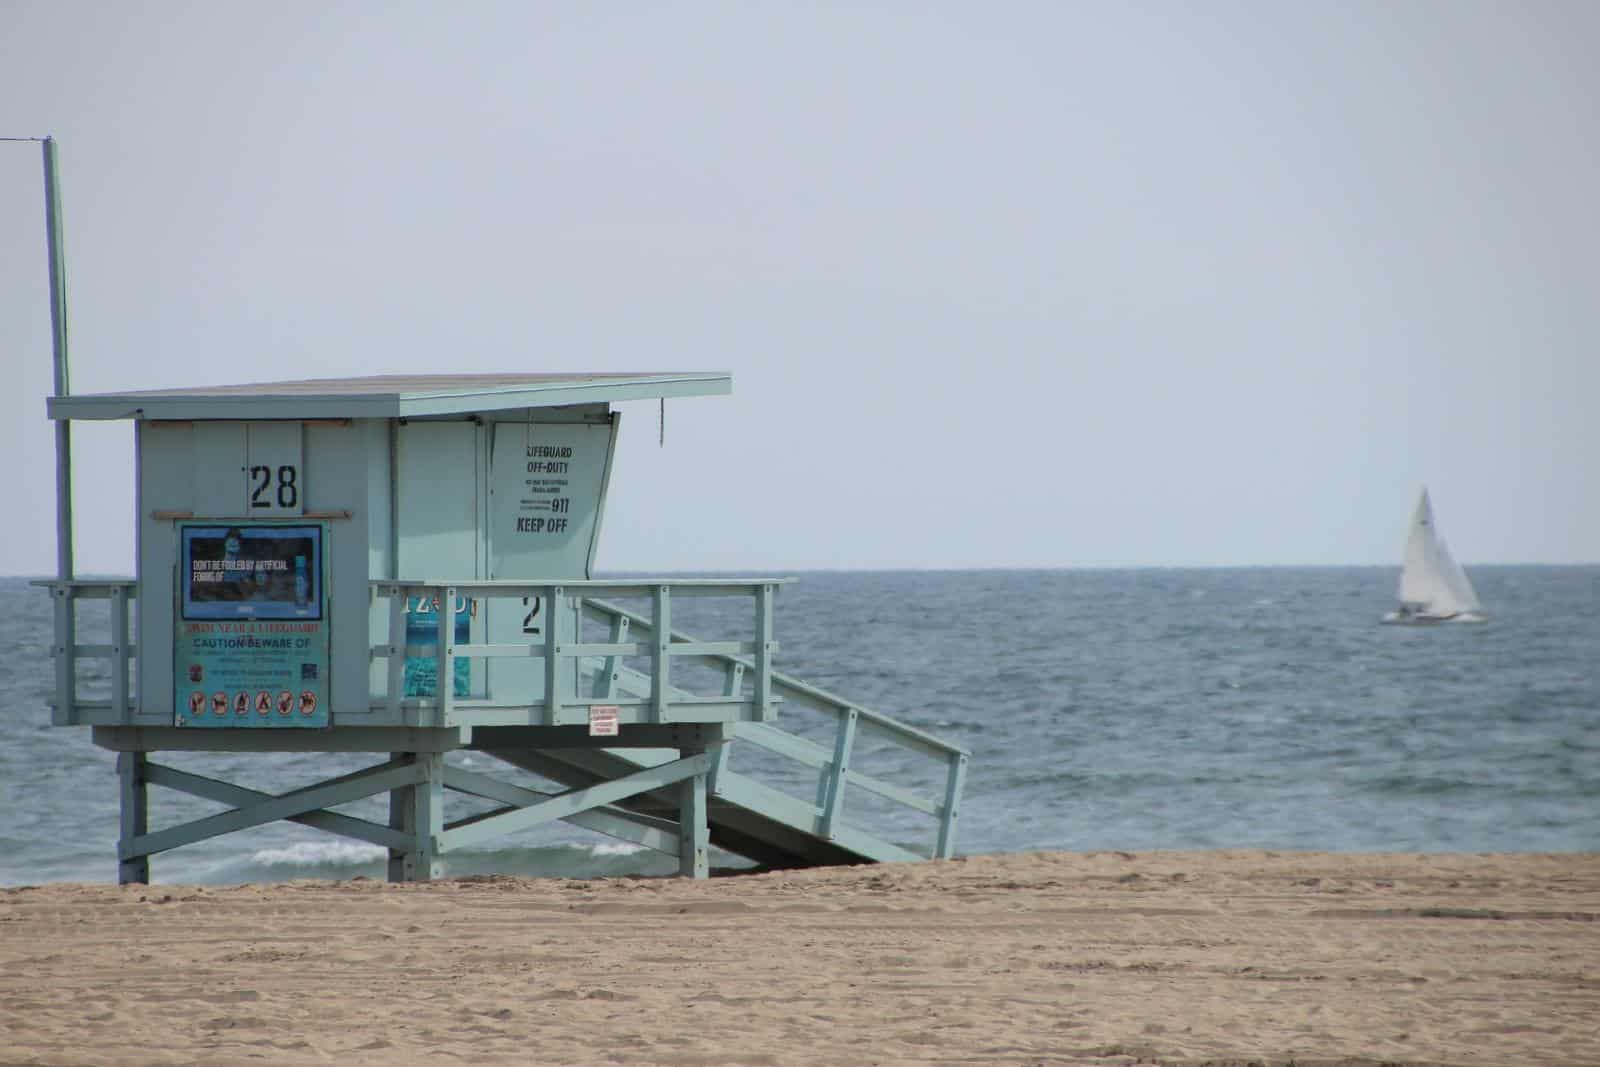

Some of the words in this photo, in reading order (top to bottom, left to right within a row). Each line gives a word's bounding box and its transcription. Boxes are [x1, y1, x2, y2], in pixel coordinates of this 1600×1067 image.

[527, 446, 573, 458] LIFEGUARD
[527, 461, 569, 473] OFF-DUTY
[250, 465, 297, 508] 28
[551, 498, 570, 513] 911
[517, 517, 545, 533] KEEP
[547, 518, 568, 533] OFF
[247, 638, 292, 648] BEWARE
[295, 638, 311, 648] OF
